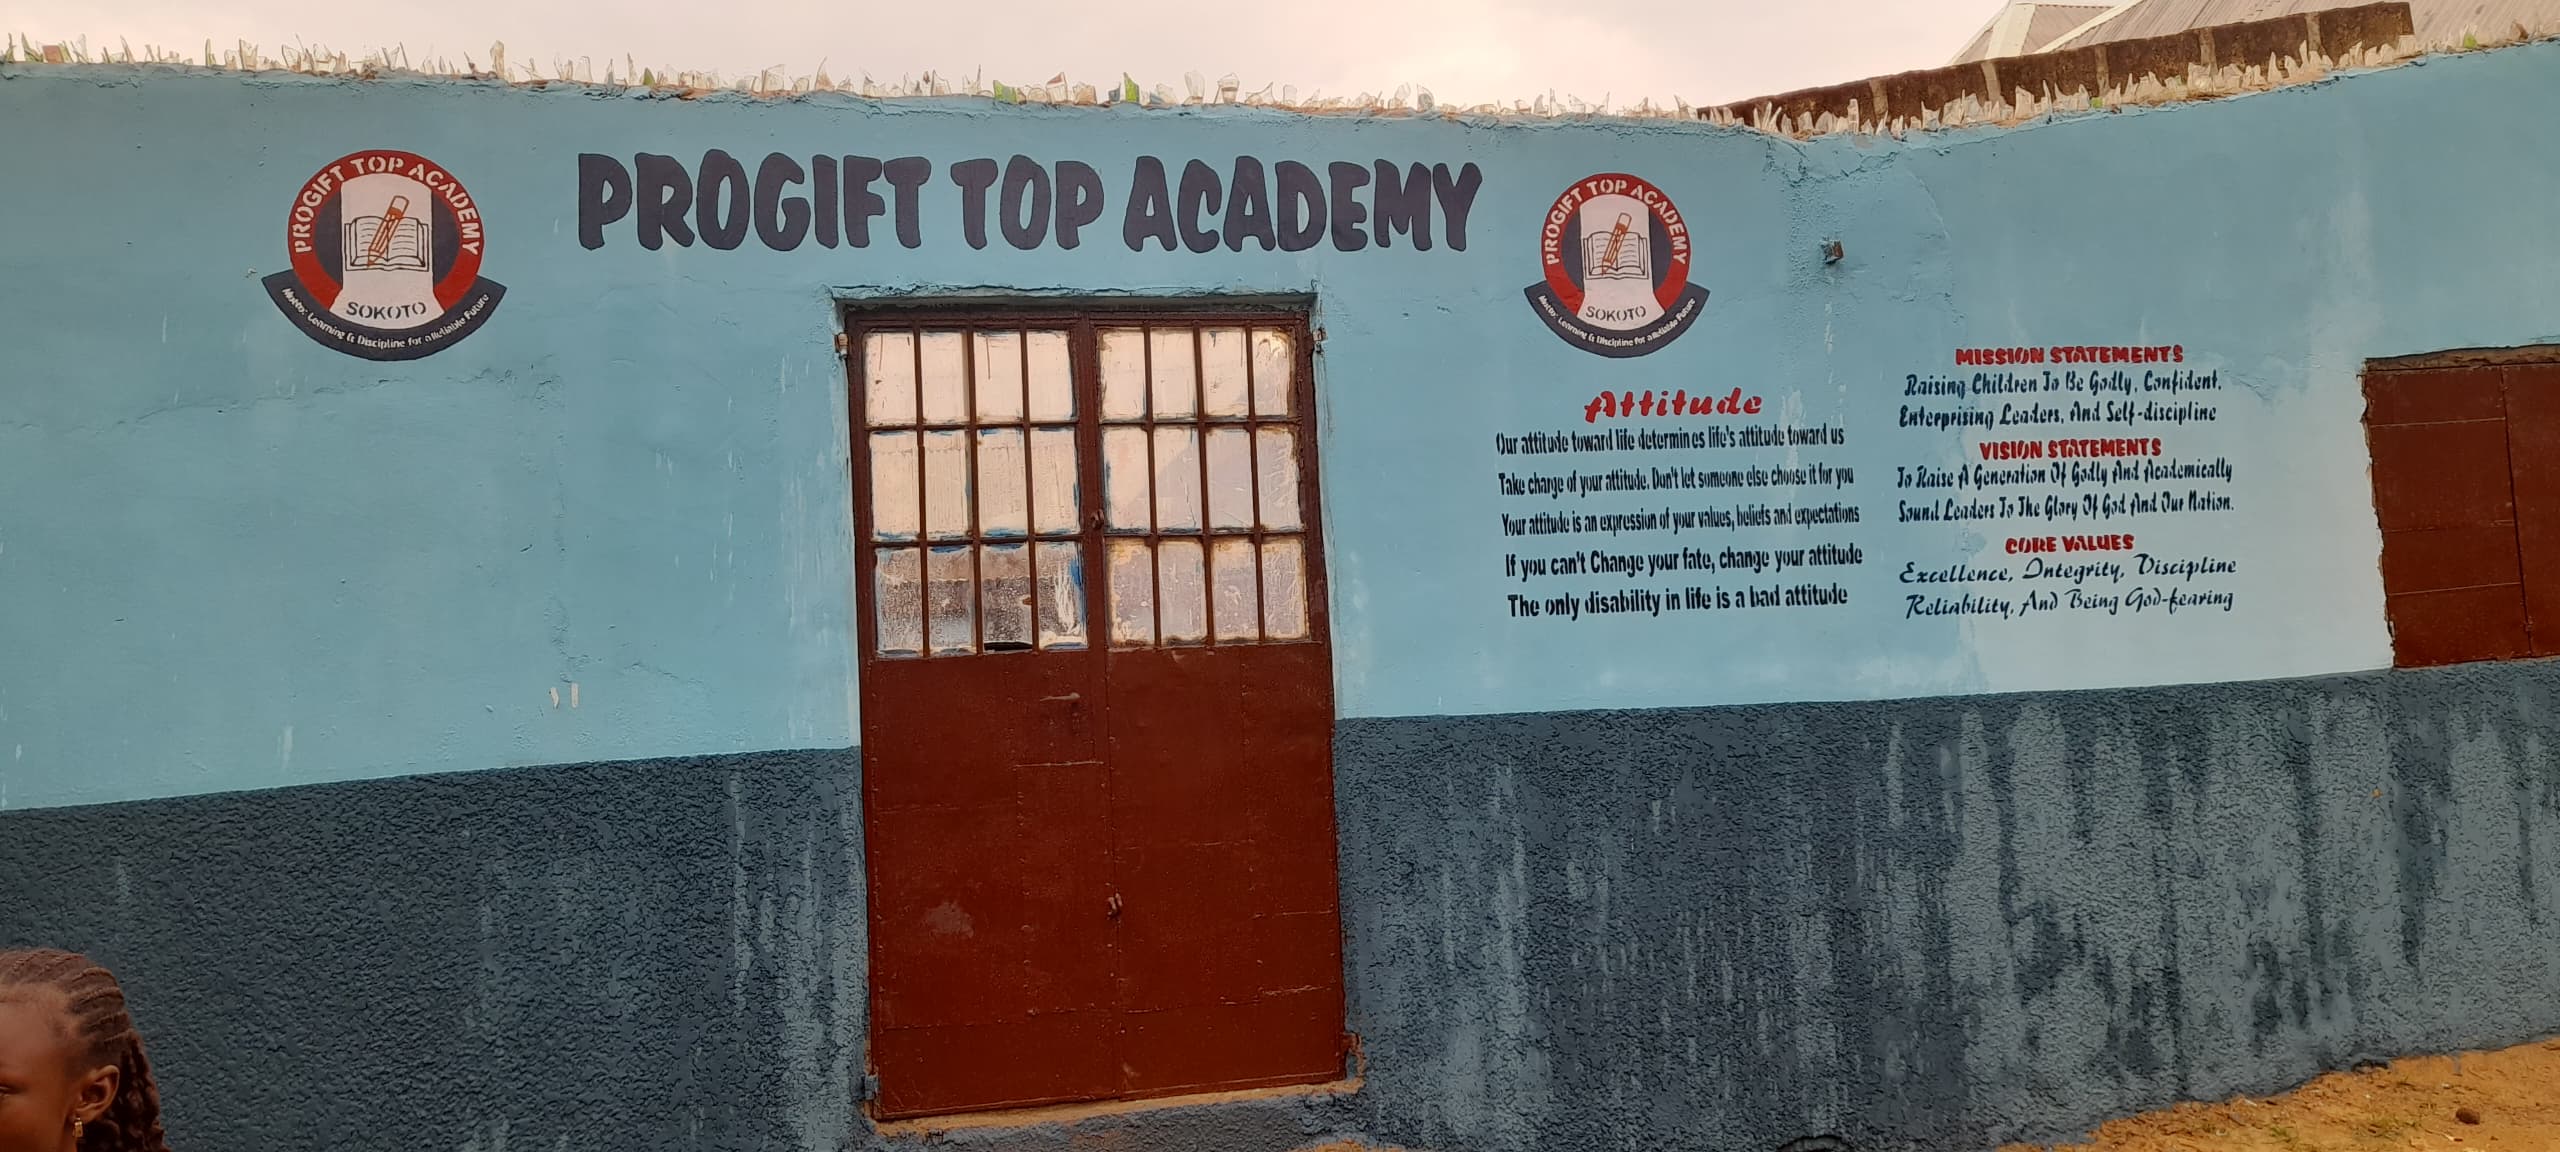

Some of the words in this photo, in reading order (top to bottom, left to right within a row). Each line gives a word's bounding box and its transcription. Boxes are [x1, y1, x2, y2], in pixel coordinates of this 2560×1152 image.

[292, 166, 345, 254] PROGIFT
[350, 156, 404, 175] TOP
[408, 163, 480, 255] ACADEMY
[578, 150, 931, 252] PROGIFT
[951, 154, 1104, 252] TOP
[1122, 155, 1482, 253] ACADEMY
[1544, 187, 1583, 265] PROGIFT
[1587, 179, 1627, 196] TOP
[1630, 184, 1687, 265] ACADEMY
[282, 288, 308, 315] Motto:
[307, 312, 345, 340] Learning
[357, 335, 406, 349] Discipline
[408, 337, 422, 346] for
[464, 294, 490, 320] Future
[346, 301, 426, 320] SOKOTO
[1558, 316, 1588, 340] Learning
[1597, 335, 1634, 348] Discipline
[1634, 336, 1646, 345] for
[1676, 298, 1696, 321] Future
[1586, 306, 1646, 322] SOKOTO
[1955, 346, 2045, 366] MISSION
[2050, 344, 2183, 364] STATEMENTS
[1904, 373, 1966, 400] Raising
[1972, 372, 2037, 395] Children
[2043, 371, 2060, 392] To
[2066, 370, 2083, 392] Be
[1584, 387, 1762, 423] Attitude
[1899, 404, 1994, 432] Enterprising
[2070, 400, 2100, 423] And
[2106, 400, 2217, 427] Self-discipline
[1496, 431, 1518, 455] Our
[1521, 430, 1569, 454] attitude
[1571, 428, 1613, 453] toward
[1615, 427, 1635, 451] life
[1708, 425, 1736, 449] life's
[1739, 423, 1785, 447] attitude
[1787, 422, 1827, 446] toward
[1830, 427, 1845, 445] us
[1979, 440, 2043, 460] VISION
[2047, 437, 2162, 458] STATEMENTS
[1498, 472, 1525, 496] Take
[1528, 471, 1564, 499] charge
[1567, 469, 1577, 493] of
[1580, 472, 1603, 498] your
[1651, 466, 1678, 490] Don't
[1680, 466, 1696, 489] let
[1699, 470, 1744, 488] someone
[1746, 464, 1768, 487] else
[1771, 464, 1806, 486] choose
[1808, 463, 1817, 485] it
[1818, 462, 1832, 485] for
[1835, 467, 1854, 490] you
[1897, 466, 1912, 488] To
[1916, 465, 1954, 488] Raise
[1958, 463, 1969, 490] A
[1973, 462, 2046, 491] Generation
[2051, 461, 2067, 488] Of
[2072, 460, 2107, 487] Godly
[2112, 459, 2139, 484] And
[2143, 456, 2232, 483] Academically
[1501, 513, 1526, 536] Your
[1529, 511, 1569, 535] attitude
[1572, 510, 1582, 533] is
[1584, 514, 1597, 532] an
[1600, 507, 1657, 537] expression
[1659, 506, 1669, 530] of
[1672, 511, 1696, 535] your
[1698, 505, 1735, 532] values,
[1736, 503, 1771, 527] beliefs
[1773, 502, 1792, 526] and
[1795, 501, 1860, 530] expectations
[1898, 498, 1939, 523] Sound
[1943, 497, 1995, 521] Leaders
[1999, 496, 2014, 519] To
[2018, 495, 2040, 518] The
[2044, 494, 2078, 522] Glory
[2083, 493, 2098, 520] Of
[2102, 492, 2126, 520] God
[2130, 491, 2157, 517] And
[2161, 490, 2184, 513] Our
[2005, 536, 2057, 554] CORE
[2061, 534, 2135, 553] VALUES
[1506, 553, 1516, 577] If
[1520, 557, 1546, 582] you
[1550, 551, 1586, 576] can't
[1590, 550, 1644, 578] Change
[1648, 553, 1679, 577] your
[1682, 547, 1715, 574] fate,
[1719, 546, 1769, 574] change
[1775, 549, 1805, 573] your
[1808, 542, 1862, 566] attitude
[1899, 561, 2014, 584] Excellence,
[2022, 557, 2125, 585] Integrity,
[2133, 553, 2237, 582] Discipline
[1507, 594, 1540, 617] The
[1545, 592, 1580, 621] only
[1584, 589, 1660, 617] disability
[1665, 587, 1680, 611] in
[1685, 586, 1711, 610] life
[1716, 585, 1731, 609] is
[1735, 590, 1745, 608] a
[1750, 583, 1781, 607] bad
[1785, 582, 1848, 606] attitude
[2018, 589, 2059, 617] And
[2064, 588, 2119, 615] Being
[2125, 586, 2234, 615] God-fearing
